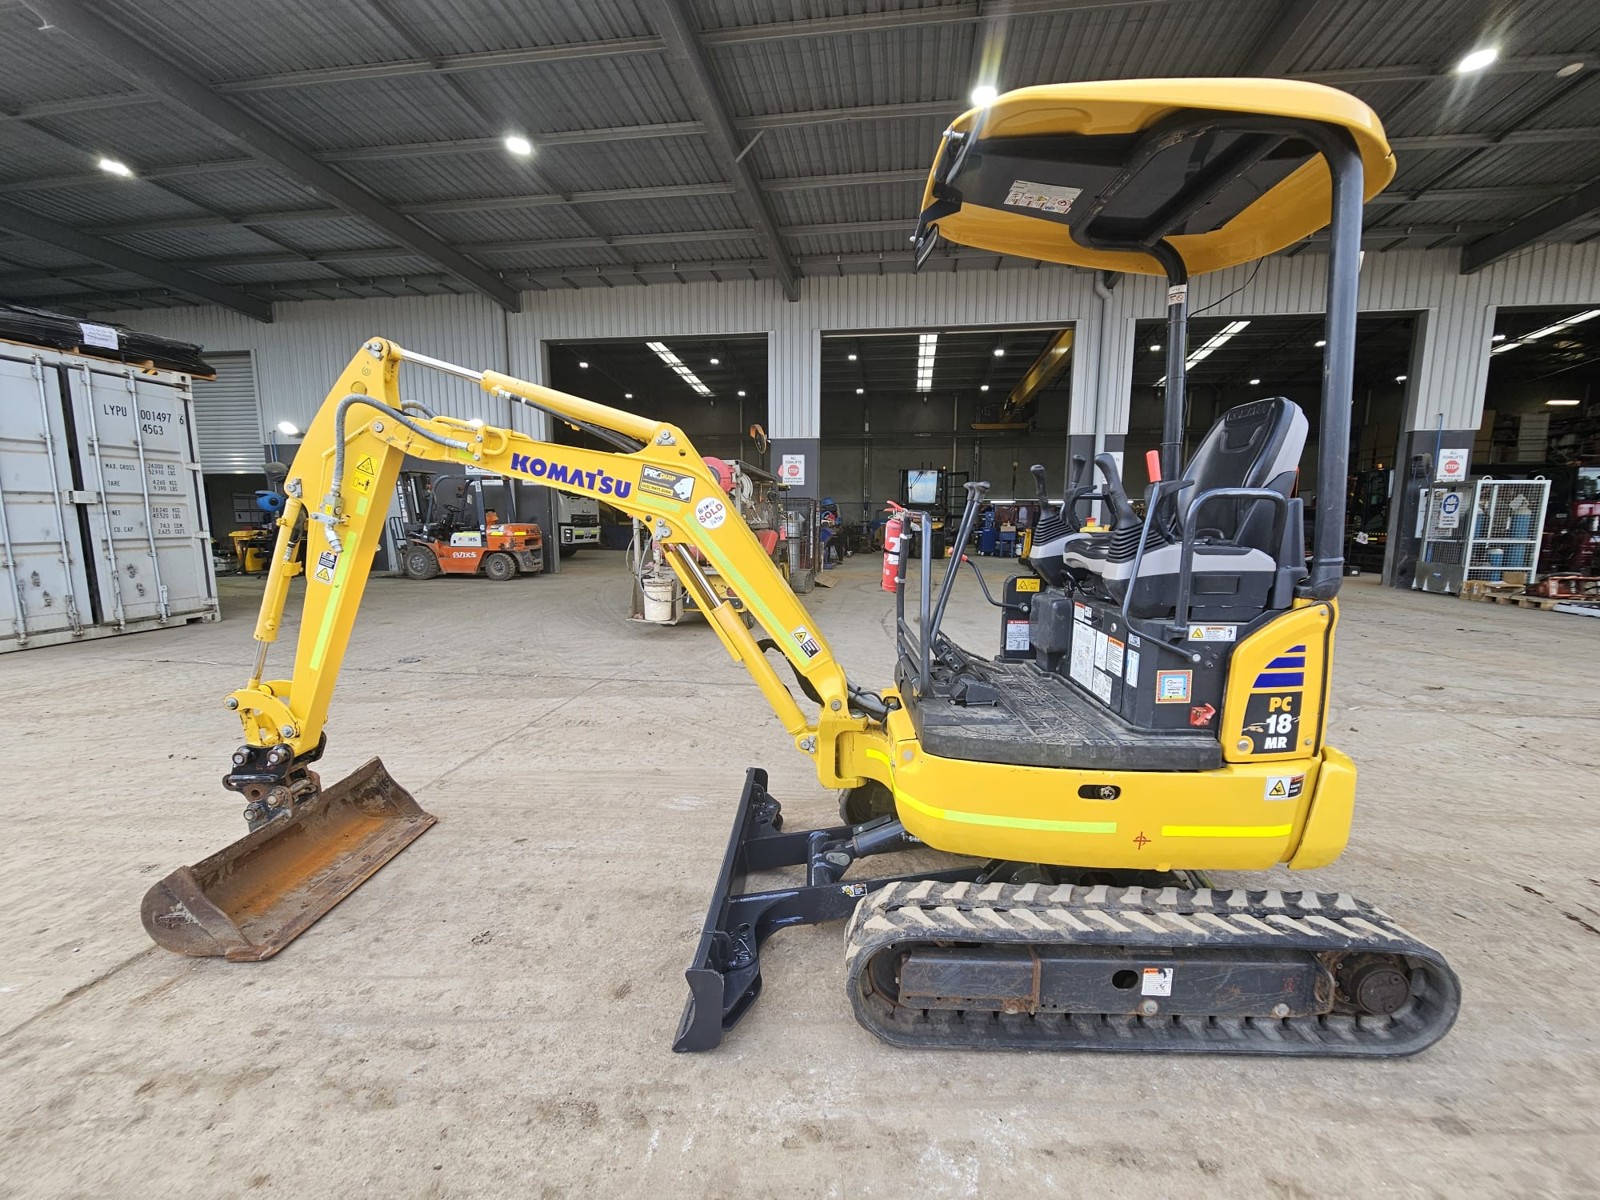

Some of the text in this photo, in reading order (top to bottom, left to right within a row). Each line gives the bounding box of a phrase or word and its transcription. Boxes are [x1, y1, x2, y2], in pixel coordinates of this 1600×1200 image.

[104, 404, 184, 424] LYPU 001497 6
[142, 424, 164, 436] 45G3
[510, 452, 632, 498] KOMATSU
[699, 504, 723, 523] SOLD
[1268, 696, 1293, 712] PC
[1266, 714, 1292, 734] 18
[1264, 737, 1288, 749] MR
